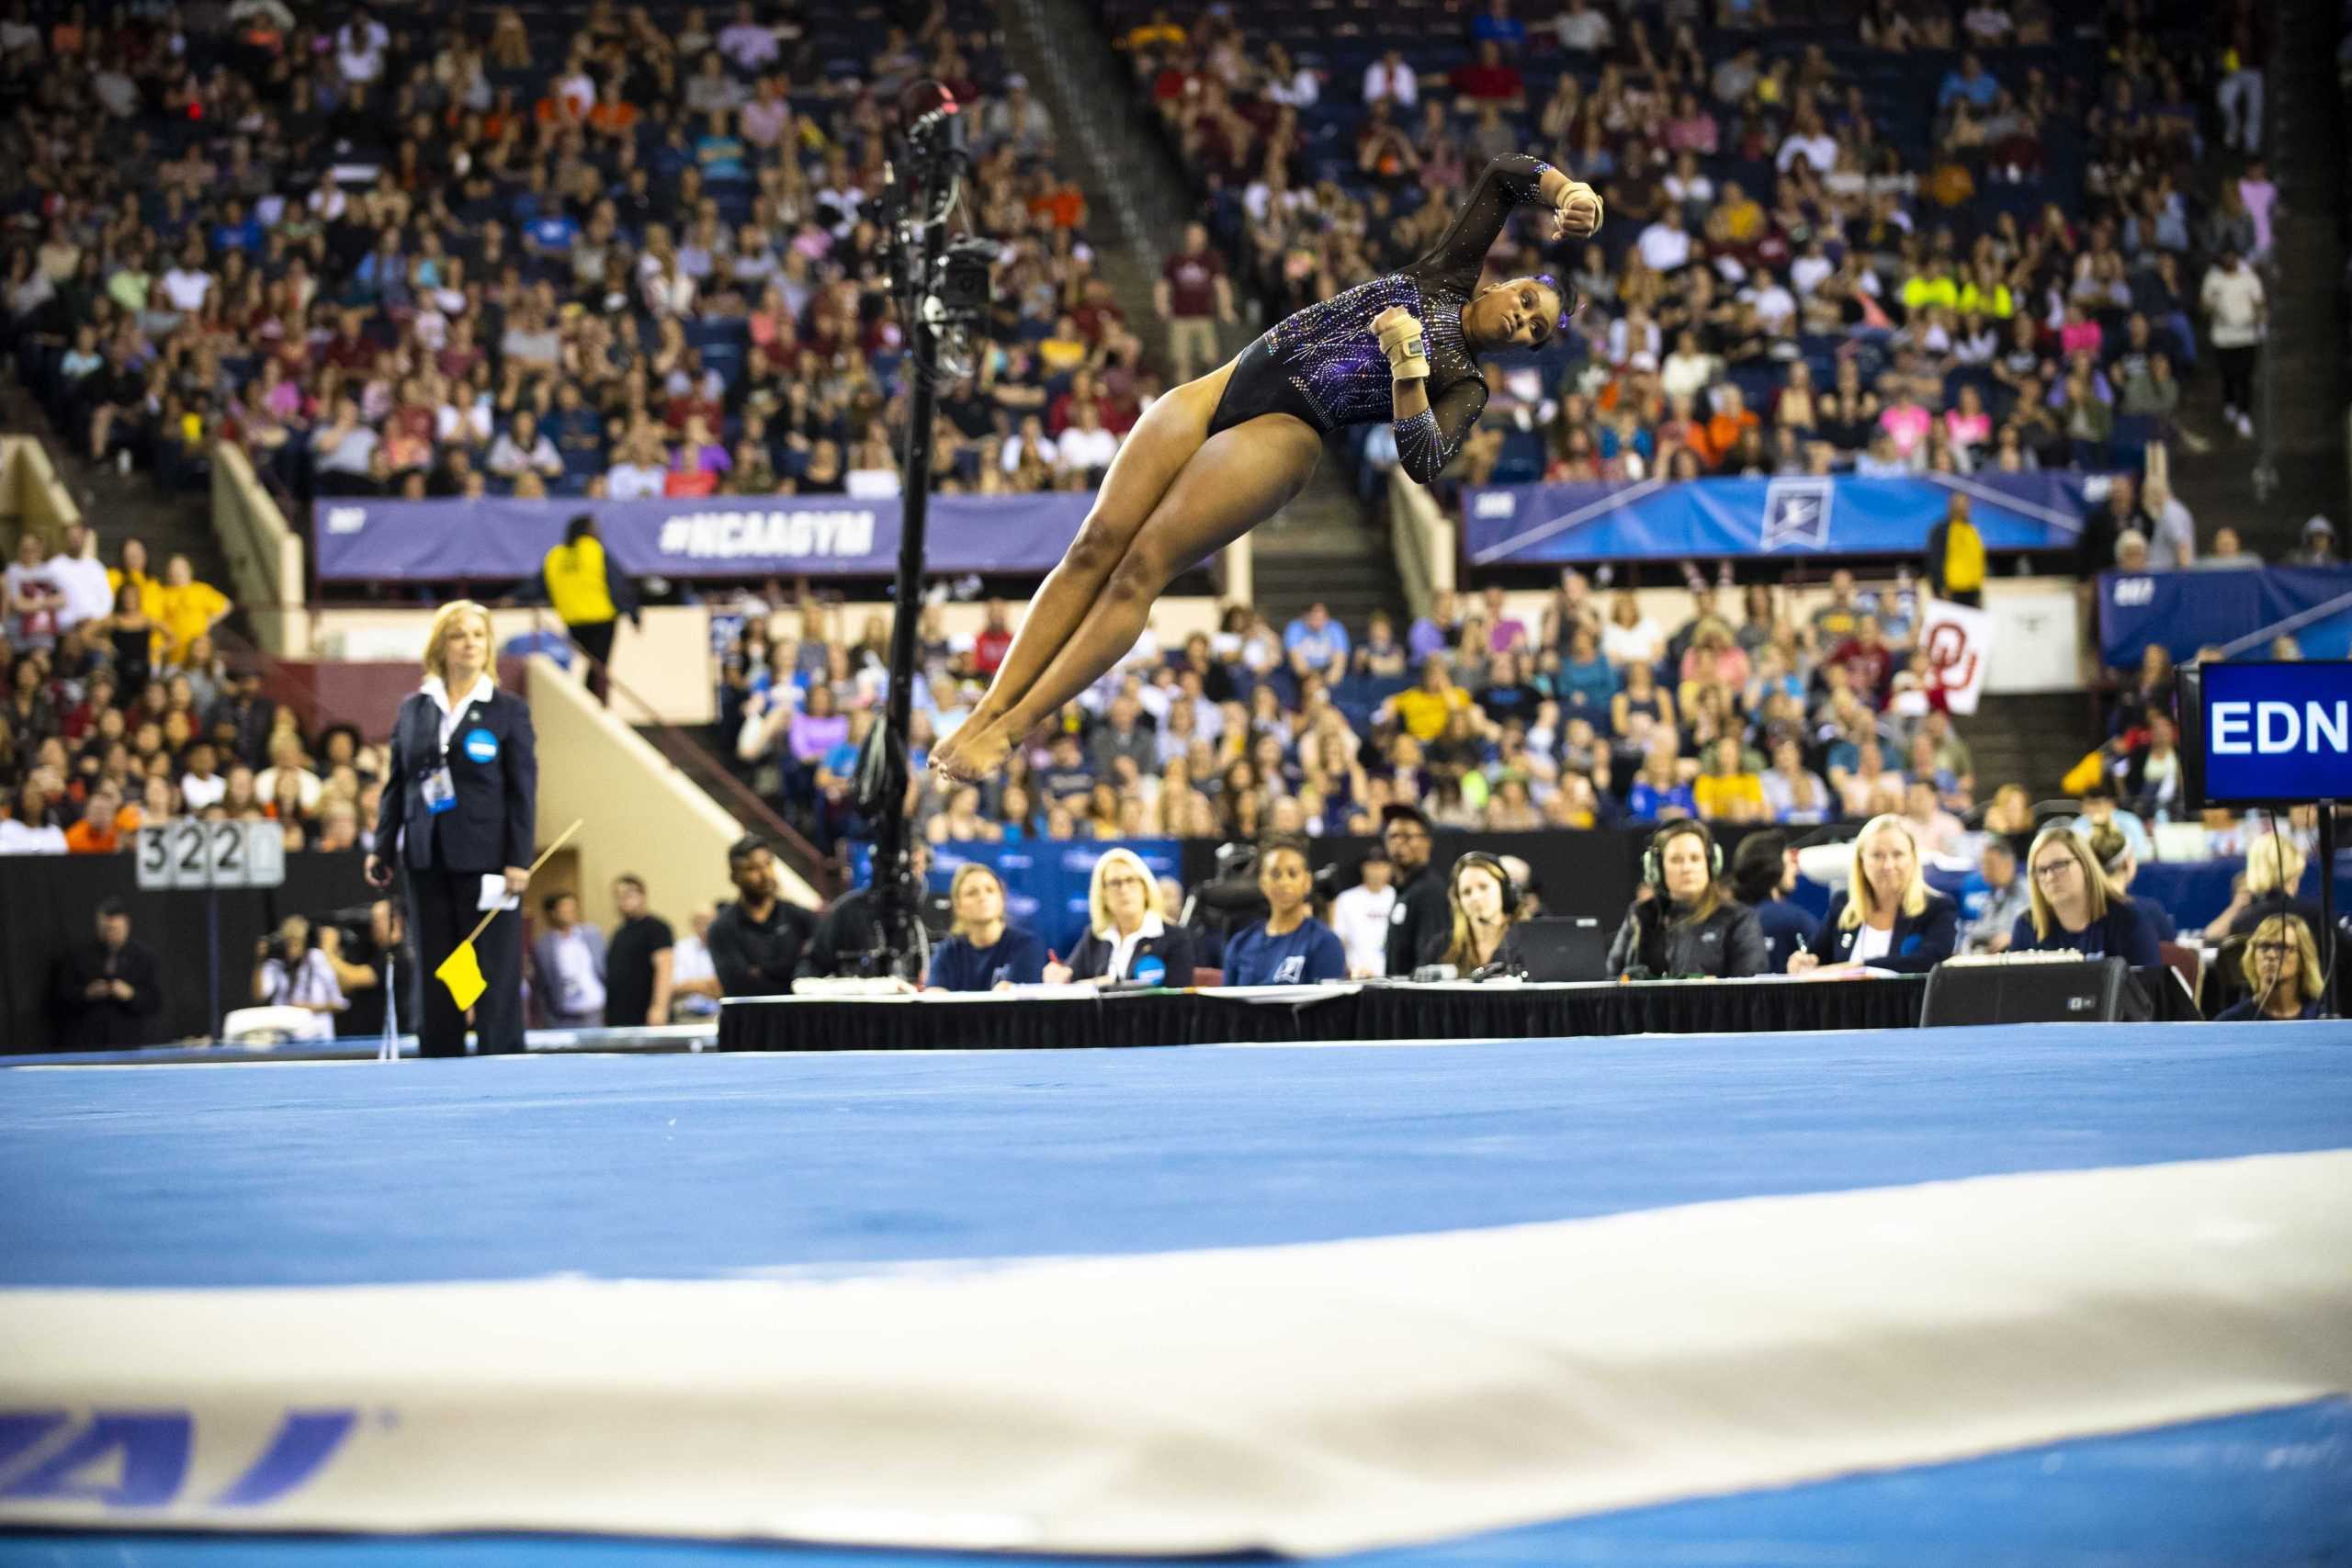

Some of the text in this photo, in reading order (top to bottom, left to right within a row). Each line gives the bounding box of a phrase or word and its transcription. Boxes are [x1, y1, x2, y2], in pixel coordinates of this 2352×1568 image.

[659, 511, 876, 558] #NCAAGYM
[2211, 700, 2349, 755] EDN
[144, 825, 242, 872] 322
